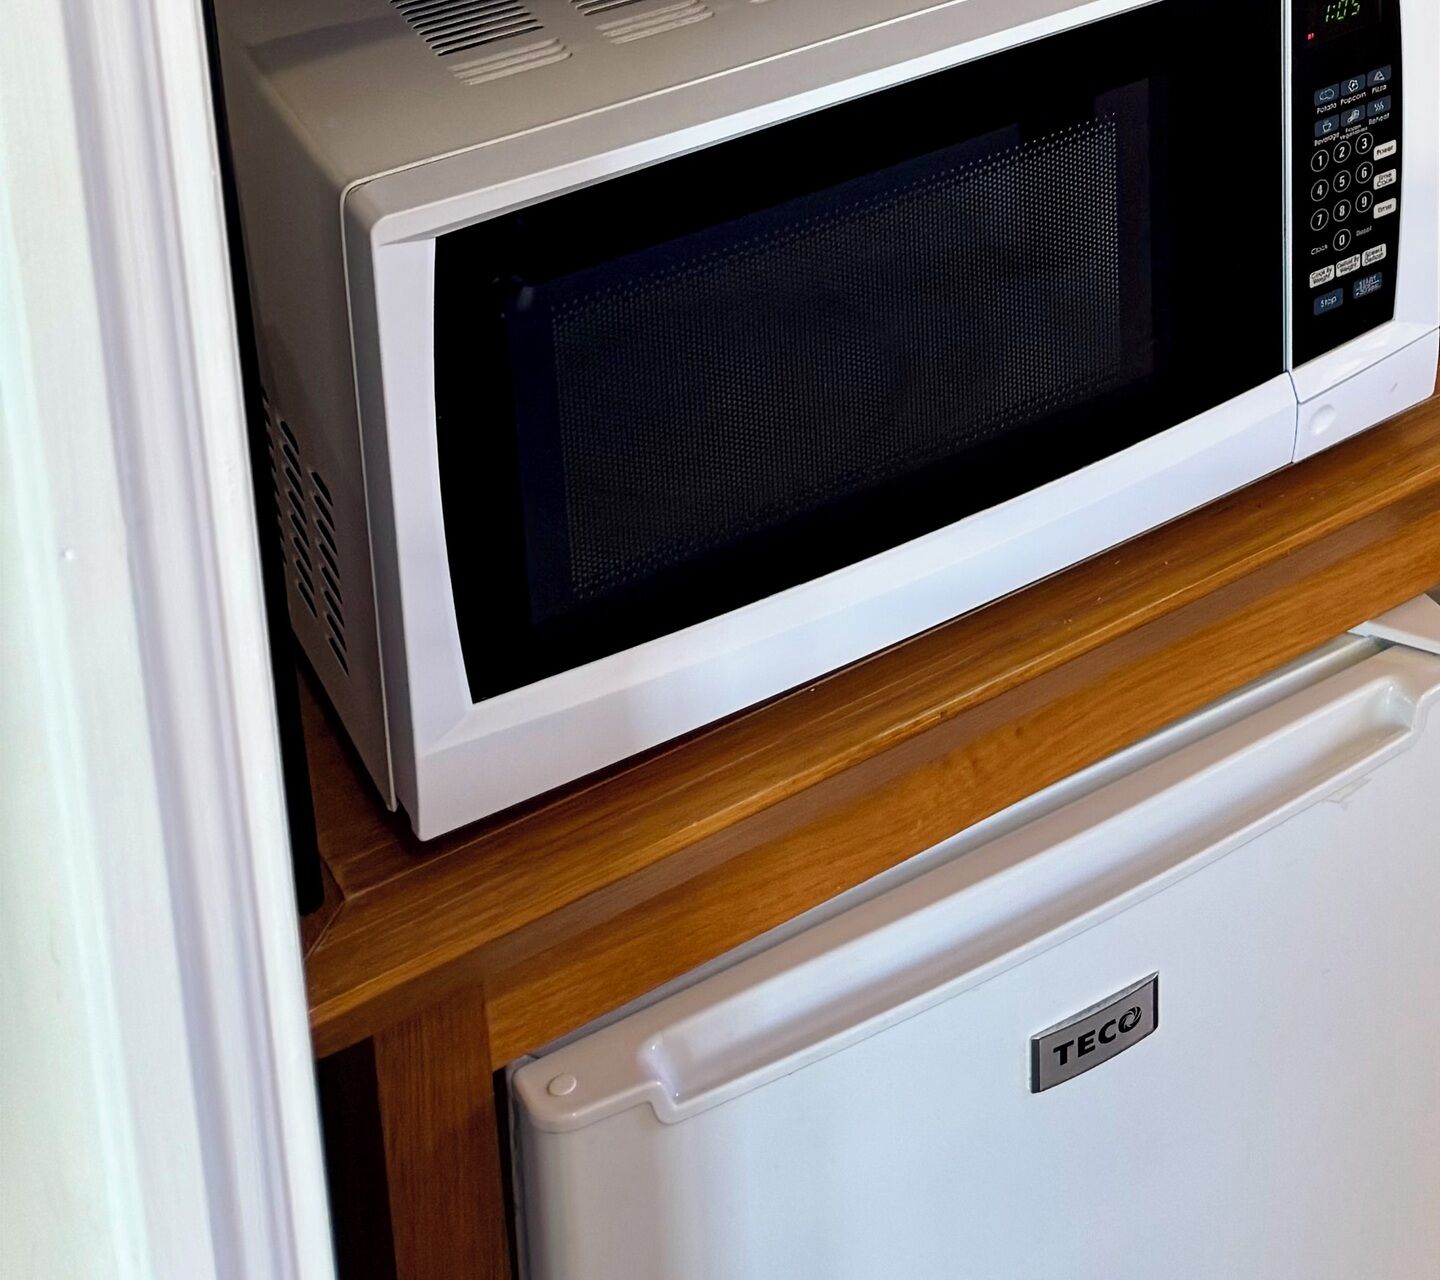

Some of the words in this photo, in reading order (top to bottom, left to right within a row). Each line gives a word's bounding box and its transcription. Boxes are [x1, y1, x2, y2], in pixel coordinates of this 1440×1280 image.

[1340, 92, 1366, 105] Popcorn
[1318, 156, 1322, 166] 1
[1340, 147, 1345, 158] 2
[1362, 138, 1367, 149] 3
[1317, 185, 1322, 196] 4
[1340, 176, 1345, 187] 5
[1362, 167, 1367, 178] 6
[1317, 214, 1322, 225] 7
[1340, 206, 1345, 216] 8
[1362, 196, 1367, 207] 9
[1340, 234, 1345, 246] 0
[1320, 296, 1336, 308] Stop
[1053, 1006, 1142, 1066] TECO
